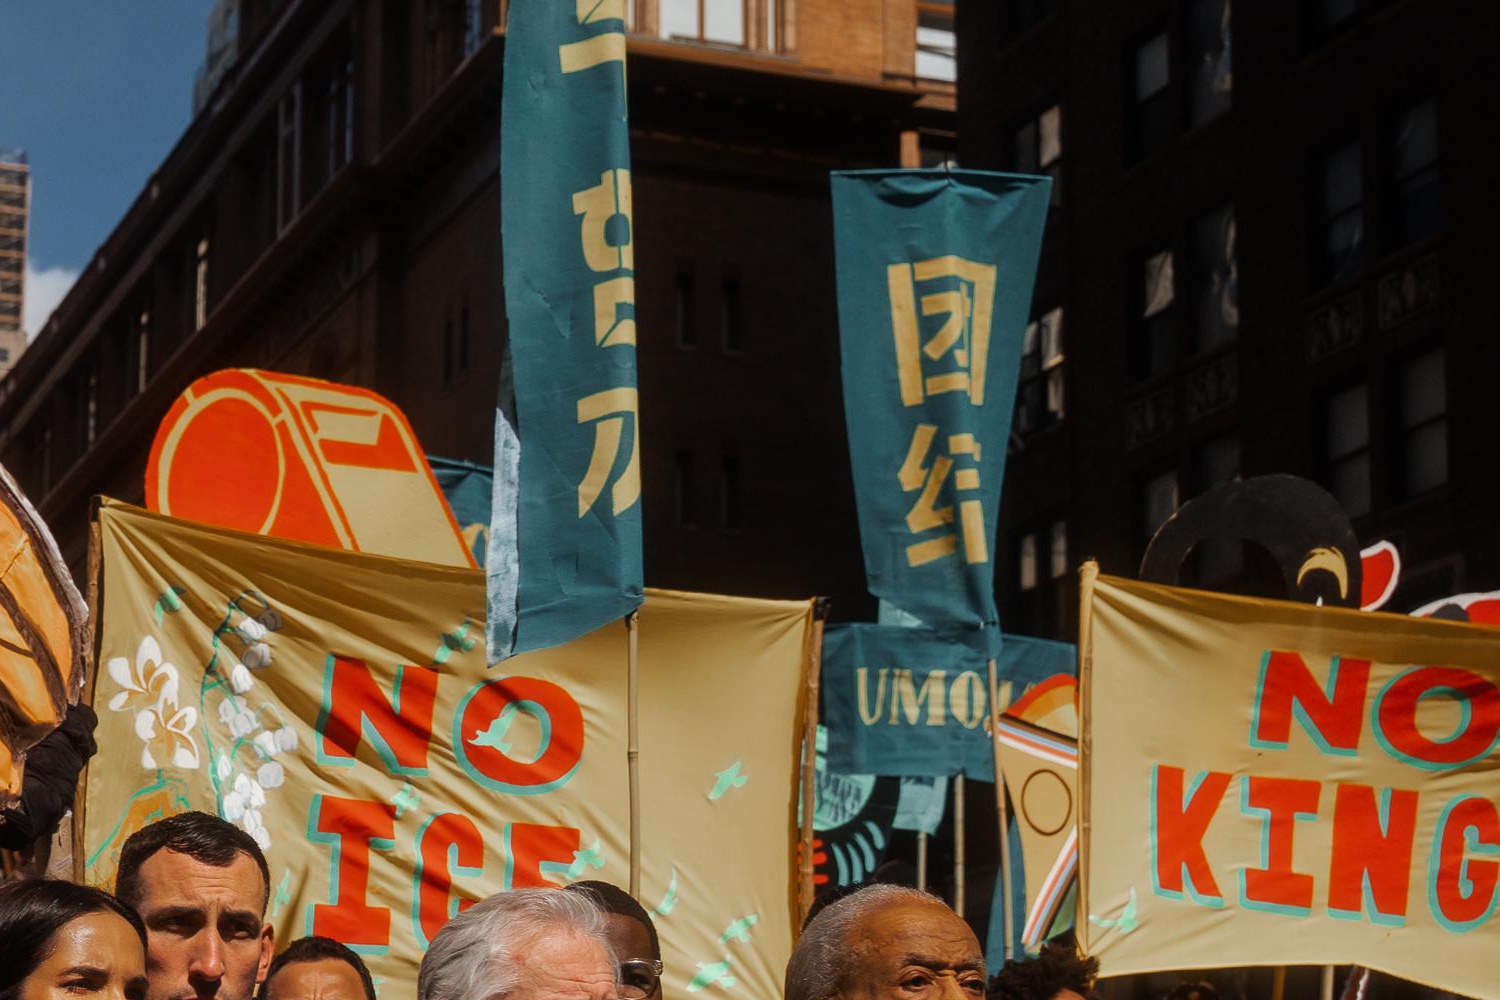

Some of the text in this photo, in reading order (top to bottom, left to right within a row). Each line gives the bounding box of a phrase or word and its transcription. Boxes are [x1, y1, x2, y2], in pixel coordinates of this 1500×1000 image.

[315, 653, 585, 796] NO
[1249, 649, 1500, 772] NO
[1150, 763, 1500, 934] KING
